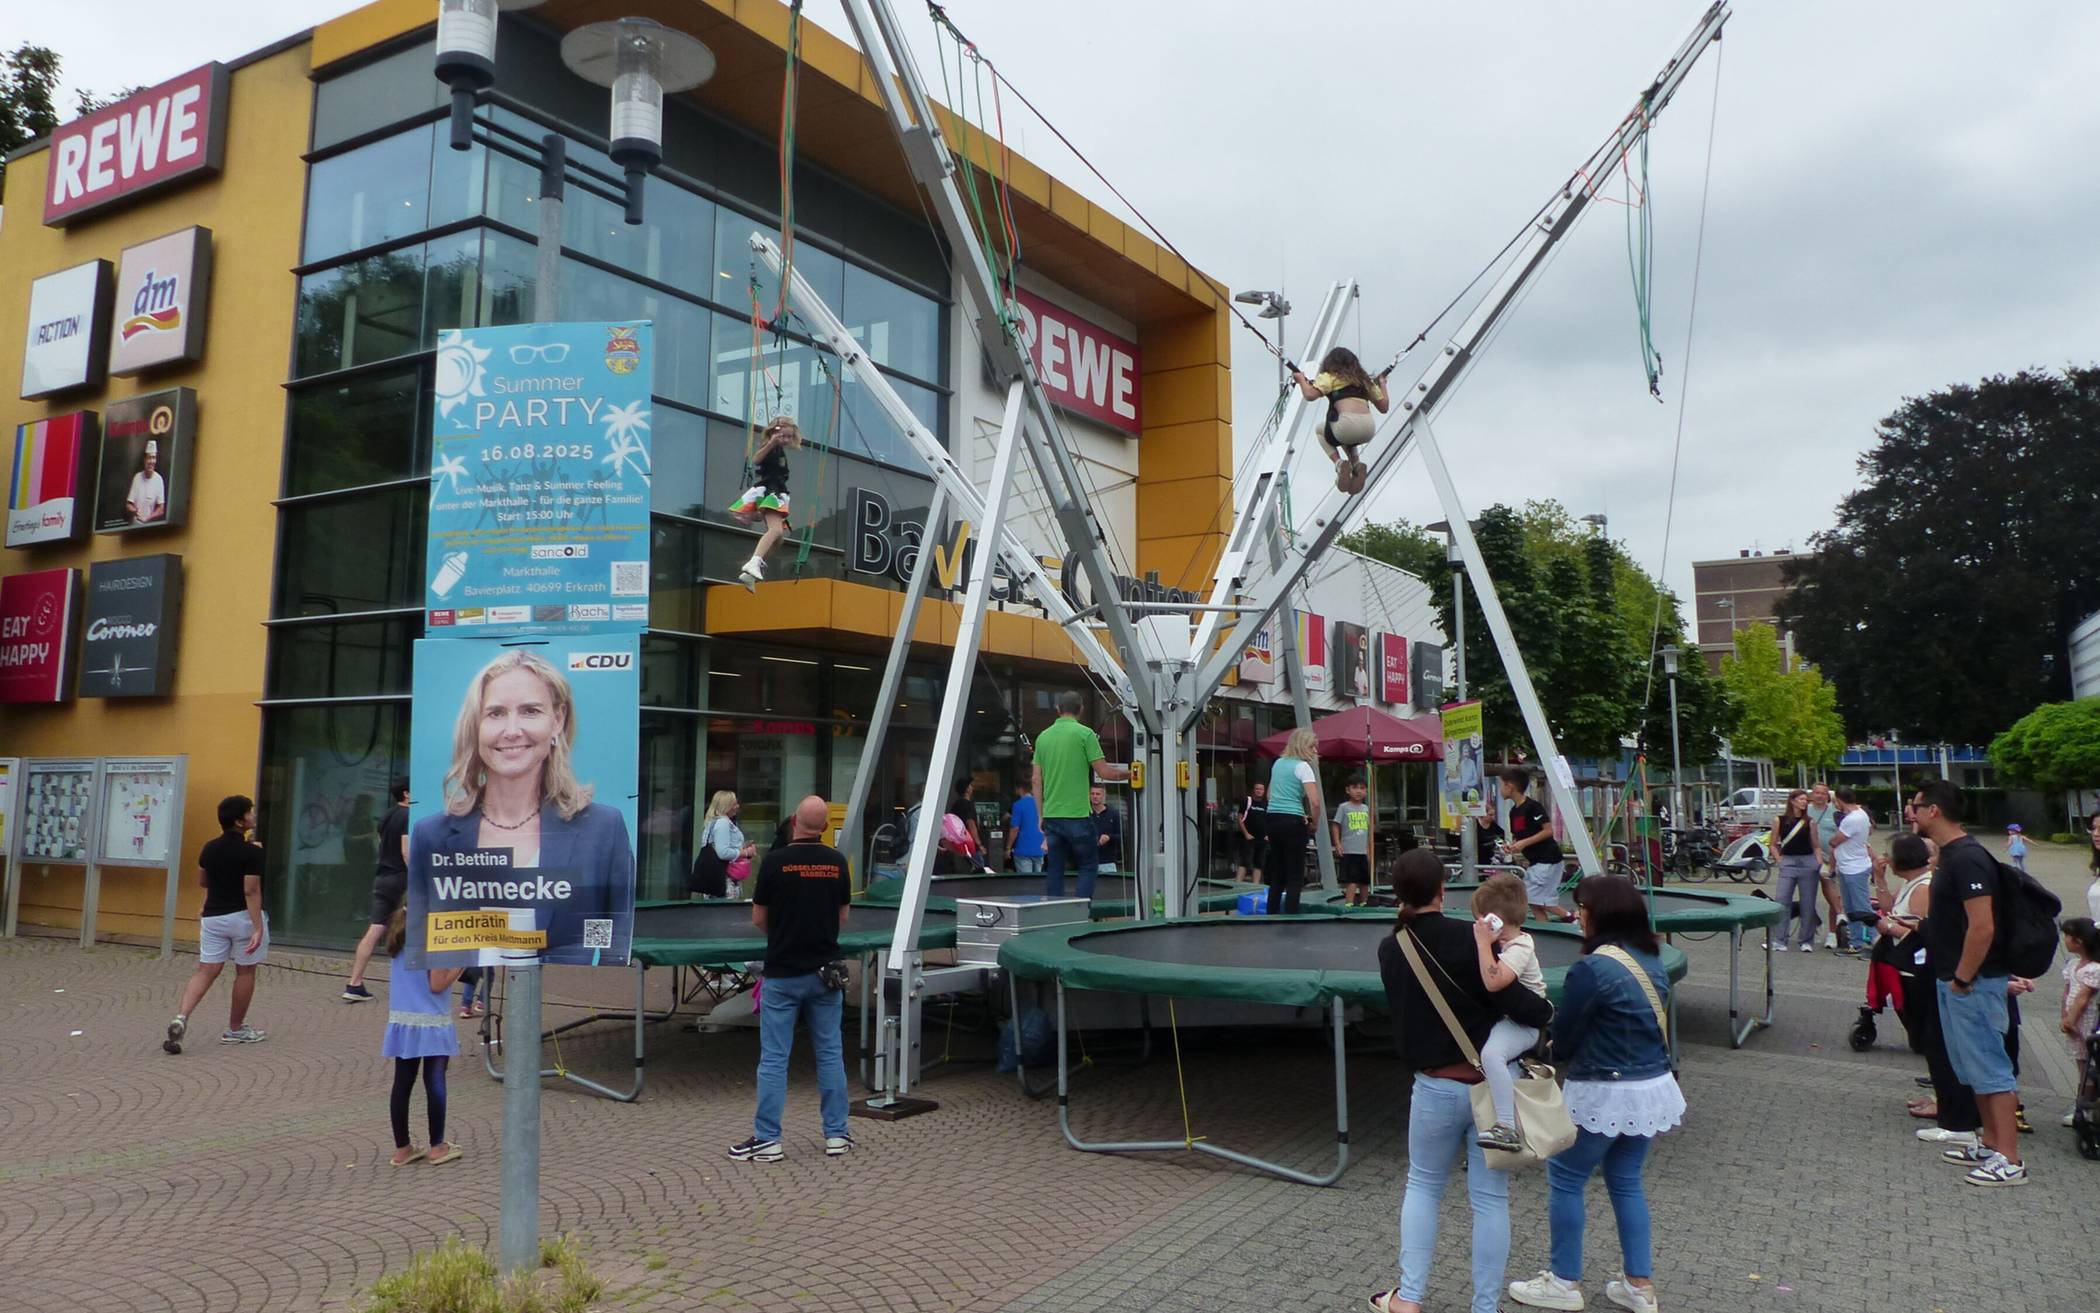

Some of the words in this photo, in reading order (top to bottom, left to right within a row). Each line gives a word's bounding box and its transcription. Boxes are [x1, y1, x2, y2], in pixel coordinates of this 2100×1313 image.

[53, 84, 201, 205] REWE
[134, 271, 177, 316] dm
[37, 315, 81, 346] ACTION
[494, 376, 584, 394] Summer
[475, 396, 604, 430] PARTY
[481, 443, 594, 462] 16.08.2025
[509, 482, 532, 492] Tanz
[534, 481, 542, 490] &
[544, 480, 585, 491] Summer
[587, 479, 624, 493] Feeling
[479, 496, 529, 508] Markthalle
[539, 495, 553, 505] für
[556, 495, 571, 505] die
[573, 496, 602, 507] ganze
[526, 510, 552, 521] 15:00
[556, 510, 574, 521] Uhr
[502, 566, 561, 577] Markthalle
[566, 582, 606, 593] Erkrath
[2, 615, 31, 638] EAT
[0, 642, 50, 667] HAPPY
[585, 654, 631, 668] CDU
[432, 852, 454, 867] Dr.
[455, 851, 508, 867] Bettina
[433, 875, 572, 901] Warnecke
[434, 914, 506, 931] Landrätin
[433, 934, 449, 945] für
[451, 934, 471, 944] den
[473, 932, 498, 943] Kreis
